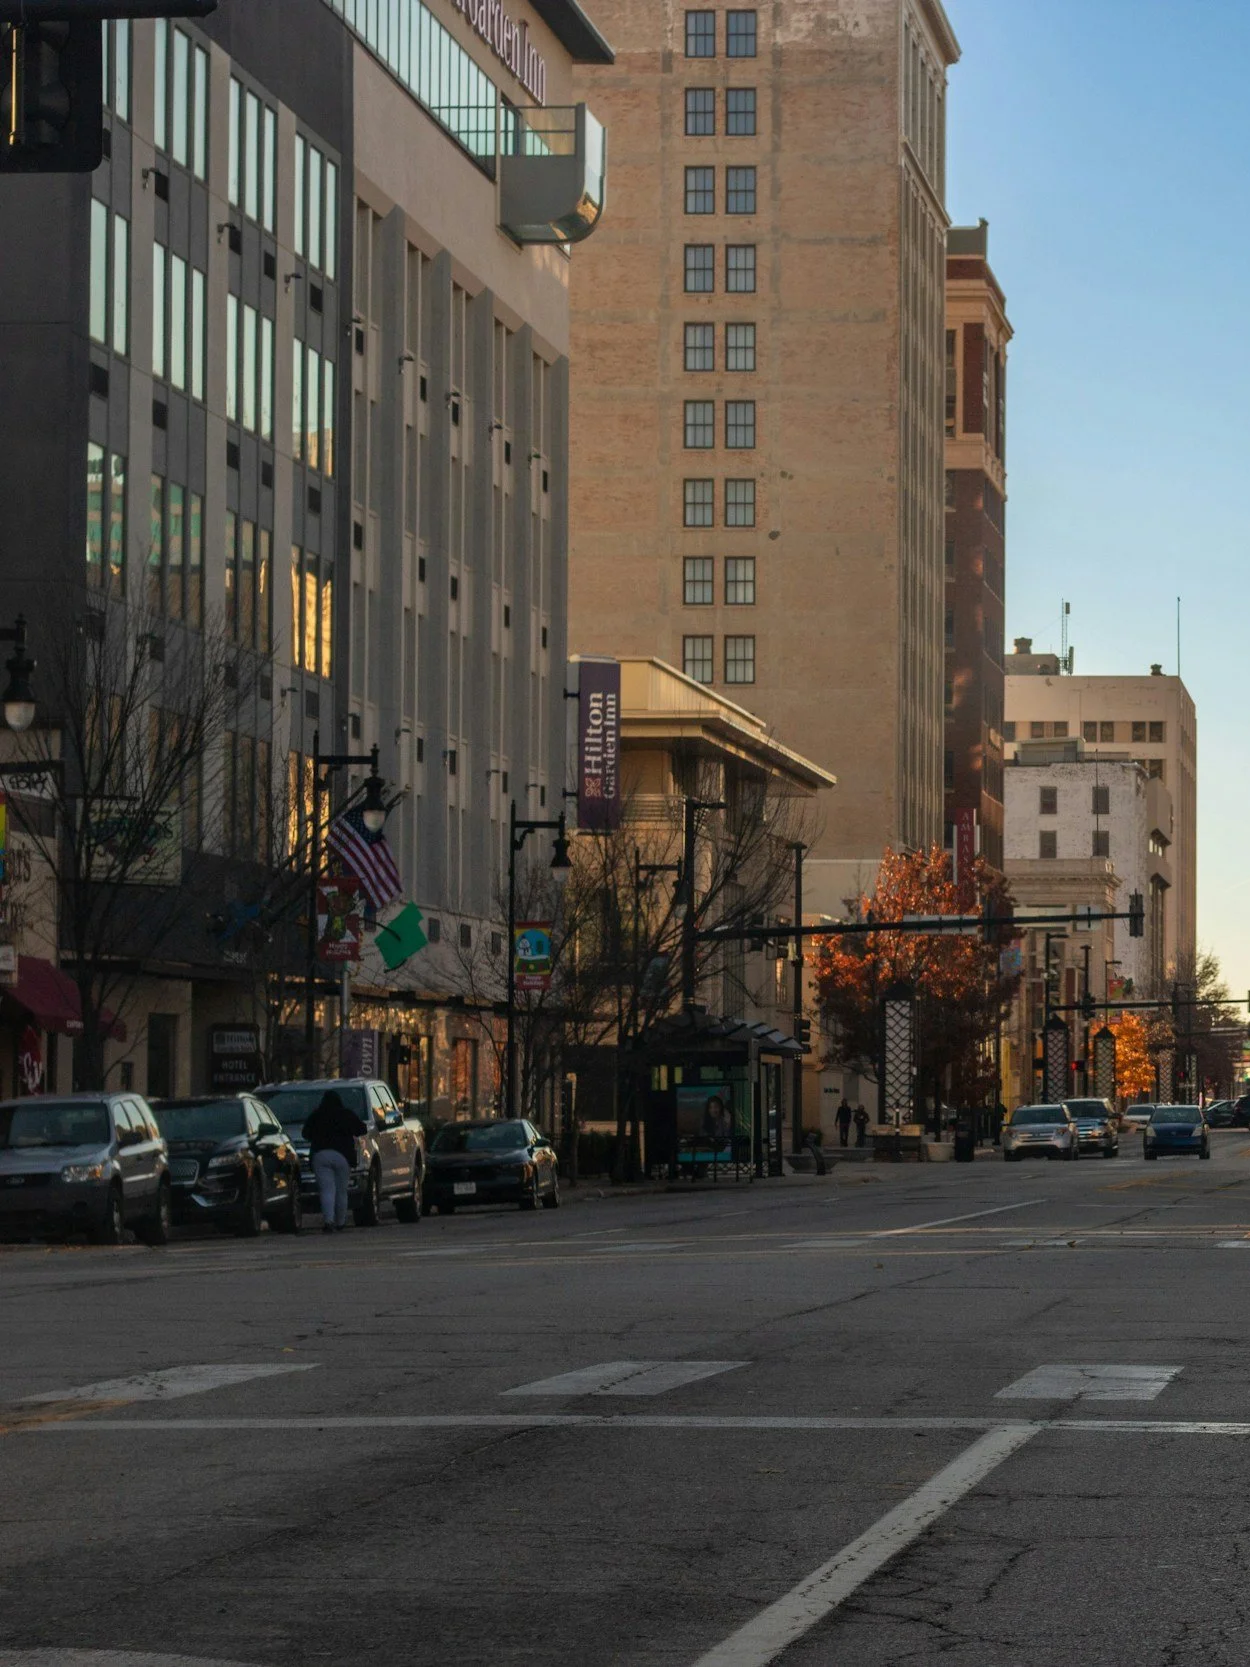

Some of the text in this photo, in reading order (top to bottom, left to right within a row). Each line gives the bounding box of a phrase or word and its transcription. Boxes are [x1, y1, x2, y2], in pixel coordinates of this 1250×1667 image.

[523, 26, 546, 107] Inn
[584, 692, 603, 774] Hilton
[603, 693, 616, 799] Garden Inn
[221, 1060, 248, 1070] HOTEL
